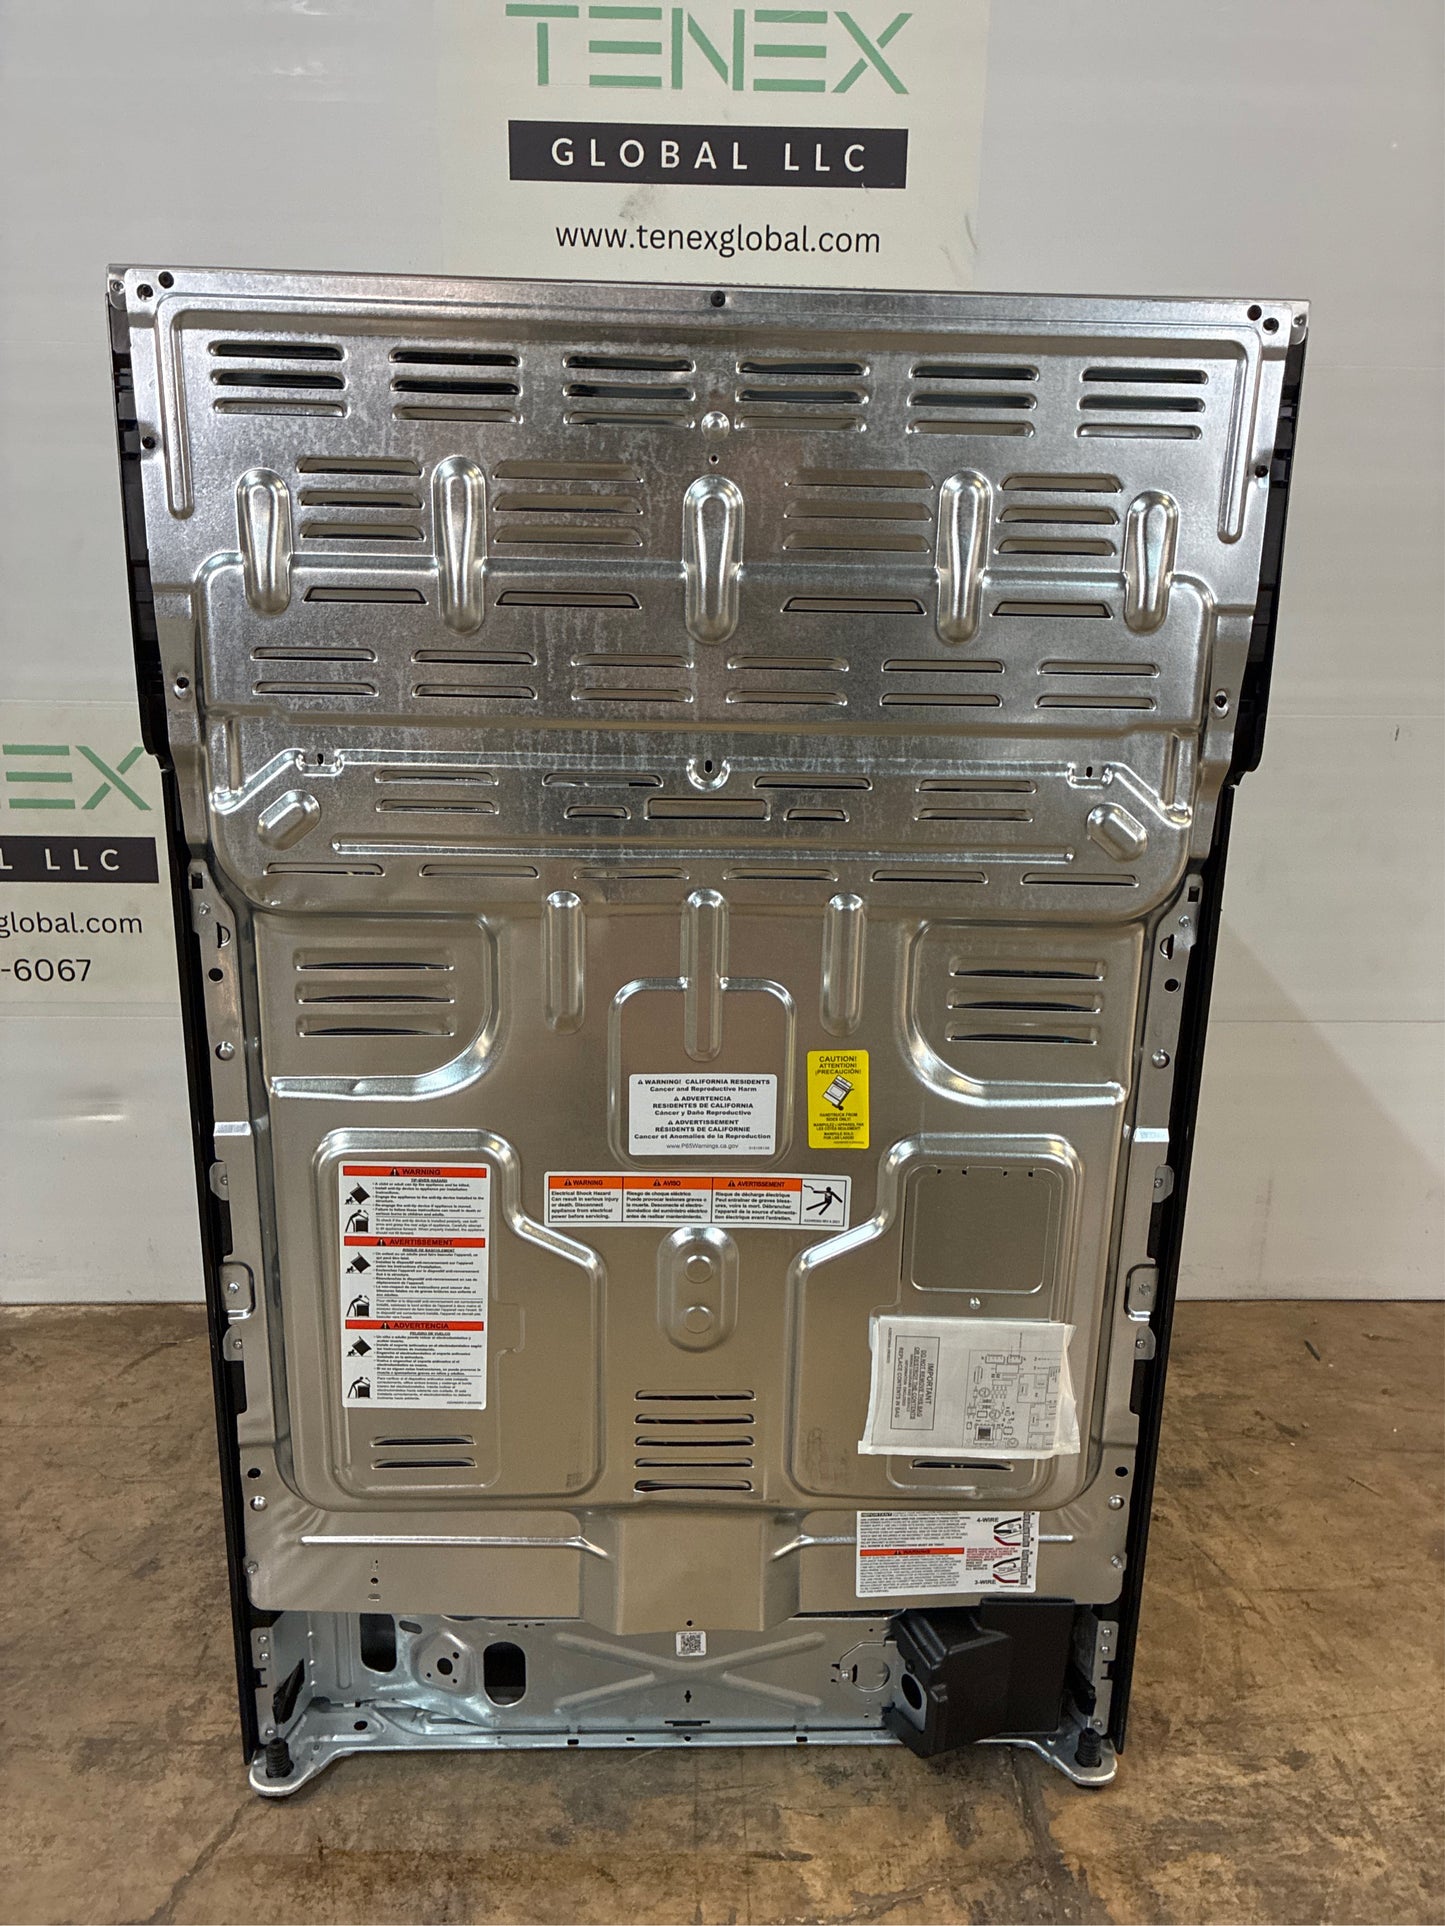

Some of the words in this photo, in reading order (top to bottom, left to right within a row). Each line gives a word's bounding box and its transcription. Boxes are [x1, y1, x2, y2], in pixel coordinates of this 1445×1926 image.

[505, 4, 913, 94] TENEX
[551, 138, 748, 170] GLOBAL
[783, 142, 866, 173] LLC
[555, 223, 881, 257] www.tenexglobal.com
[0, 744, 152, 810] EX
[44, 848, 120, 872] LLC
[925, 1363, 934, 1405] IMPORTANT
